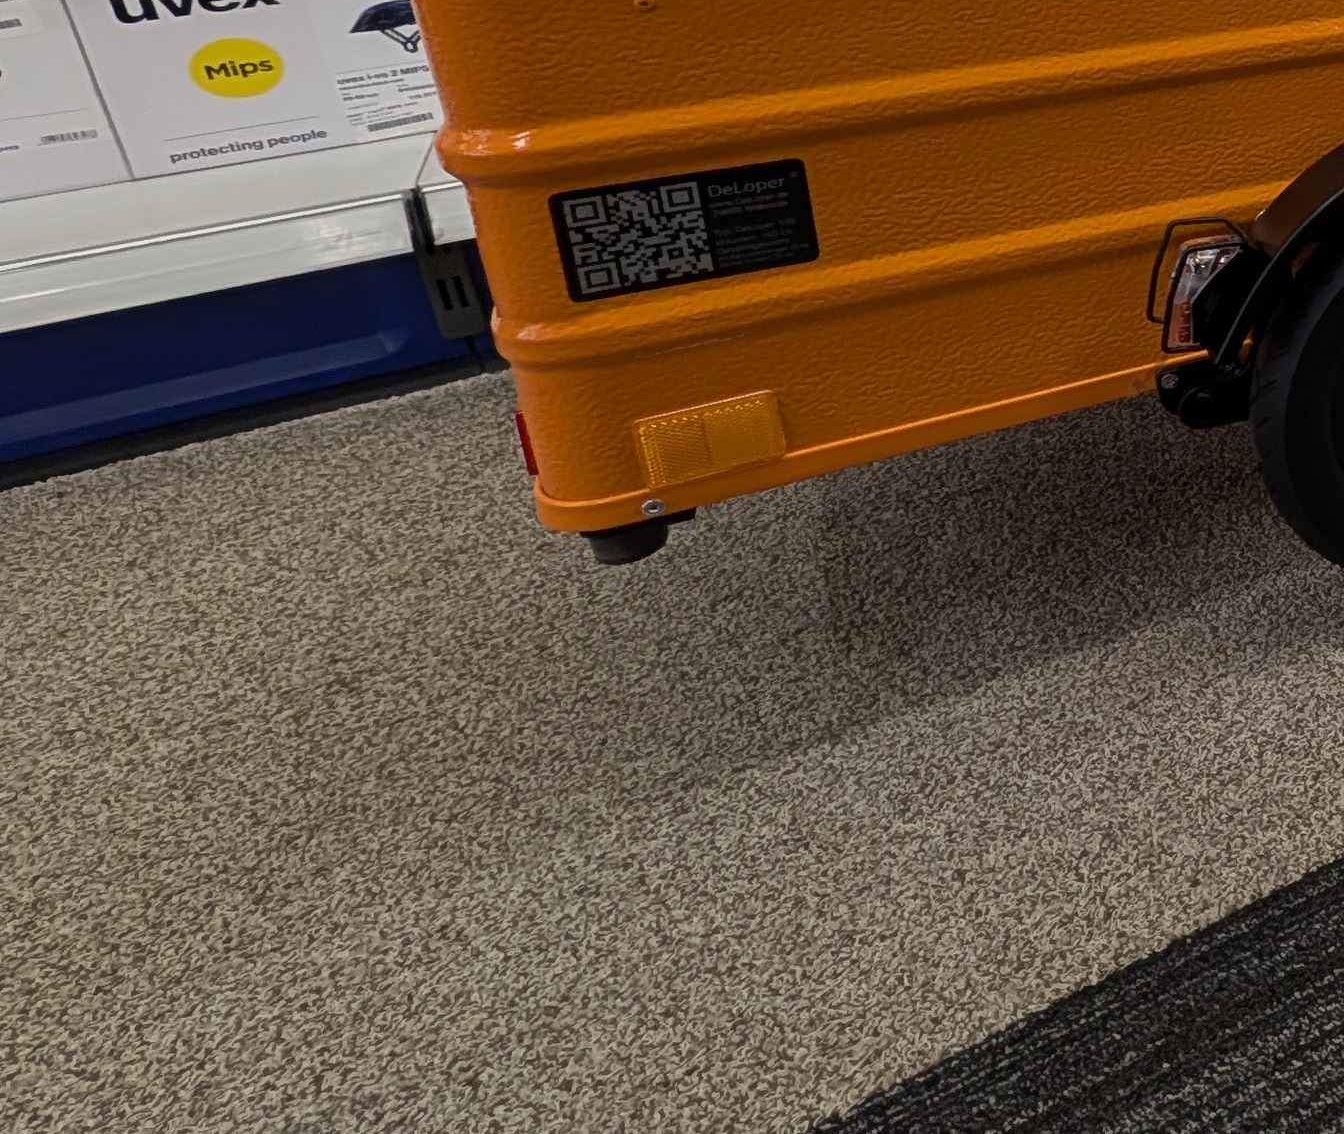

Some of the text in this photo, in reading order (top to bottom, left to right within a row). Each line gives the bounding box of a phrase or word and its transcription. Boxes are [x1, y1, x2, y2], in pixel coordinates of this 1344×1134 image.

[204, 58, 274, 80] Mips
[169, 127, 328, 164] protecting people
[707, 177, 785, 198] DeLoper
